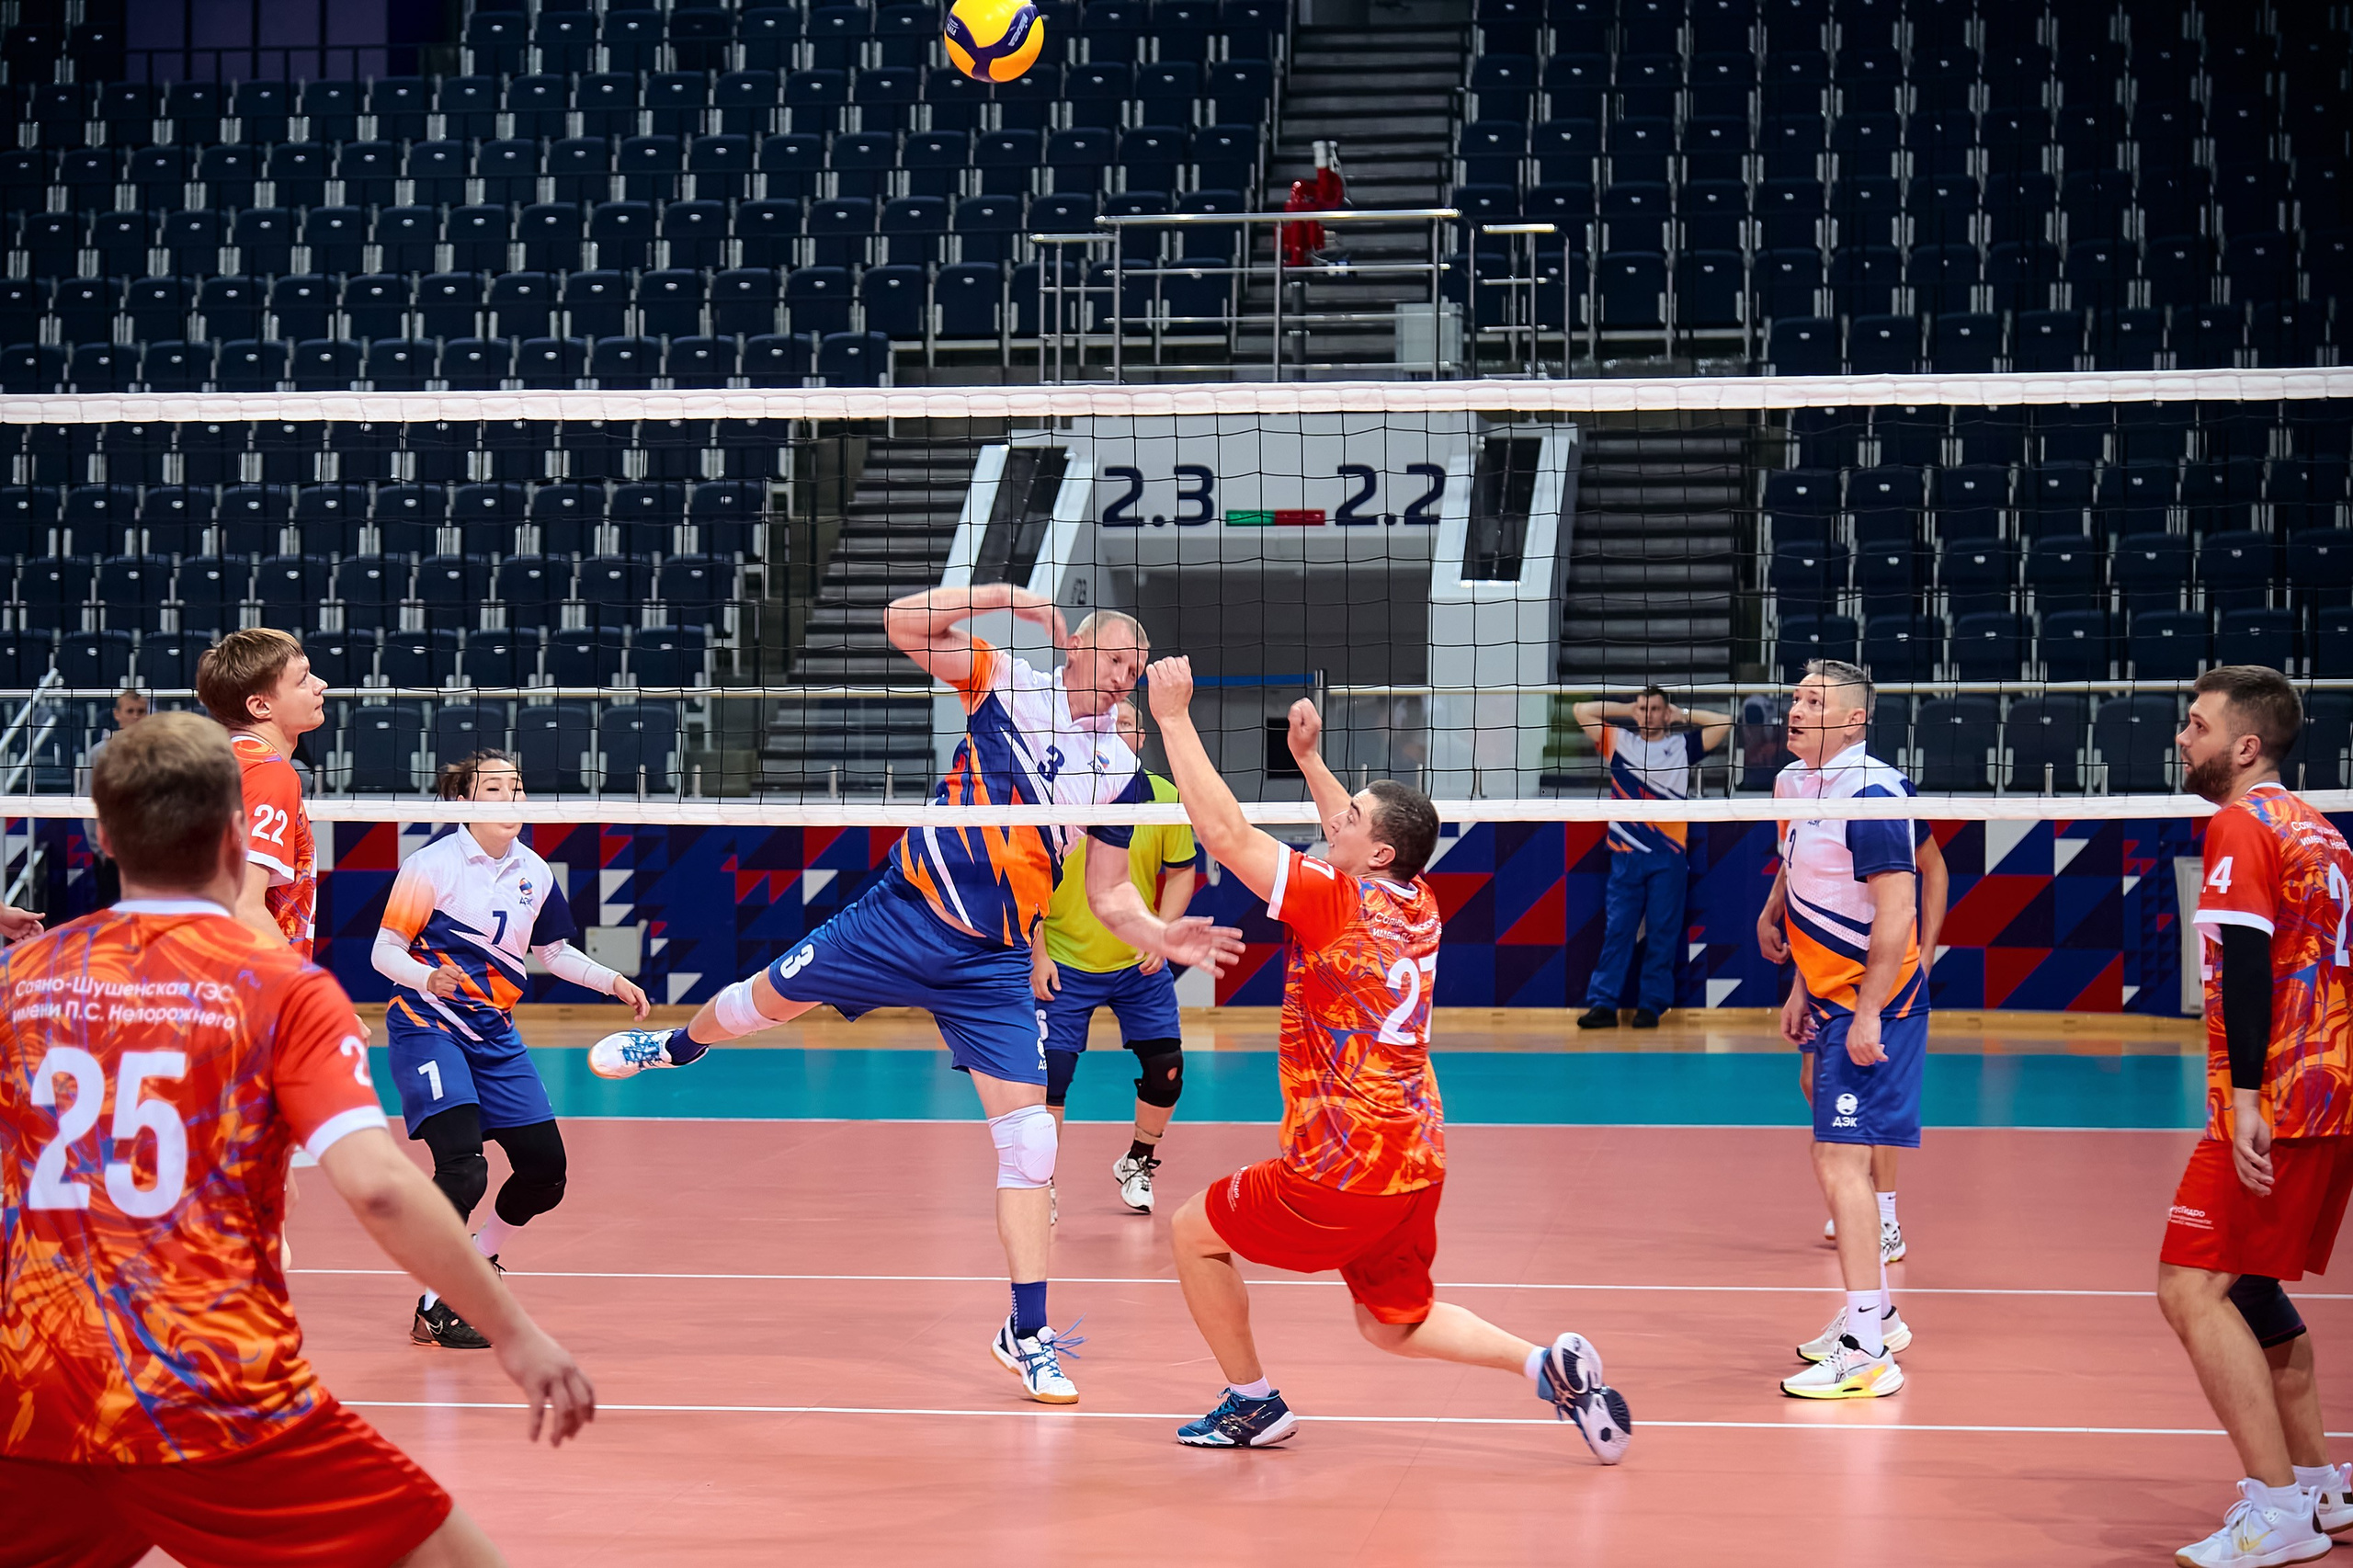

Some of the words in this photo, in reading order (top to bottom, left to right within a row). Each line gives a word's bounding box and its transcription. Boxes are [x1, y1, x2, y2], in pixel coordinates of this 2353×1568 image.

[1103, 464, 1214, 528] 2.3
[1335, 463, 1446, 527] 2.2
[1037, 744, 1064, 782] 3
[251, 803, 289, 847] 22
[491, 910, 507, 946] 7
[779, 943, 814, 980] 3
[15, 976, 190, 998] Саяно-Шушенская
[193, 981, 235, 1004] ГЭС
[1377, 951, 1438, 1046] 27
[12, 1002, 62, 1024] имени
[28, 1046, 188, 1219] 25
[1832, 1116, 1859, 1128] ДЭК
